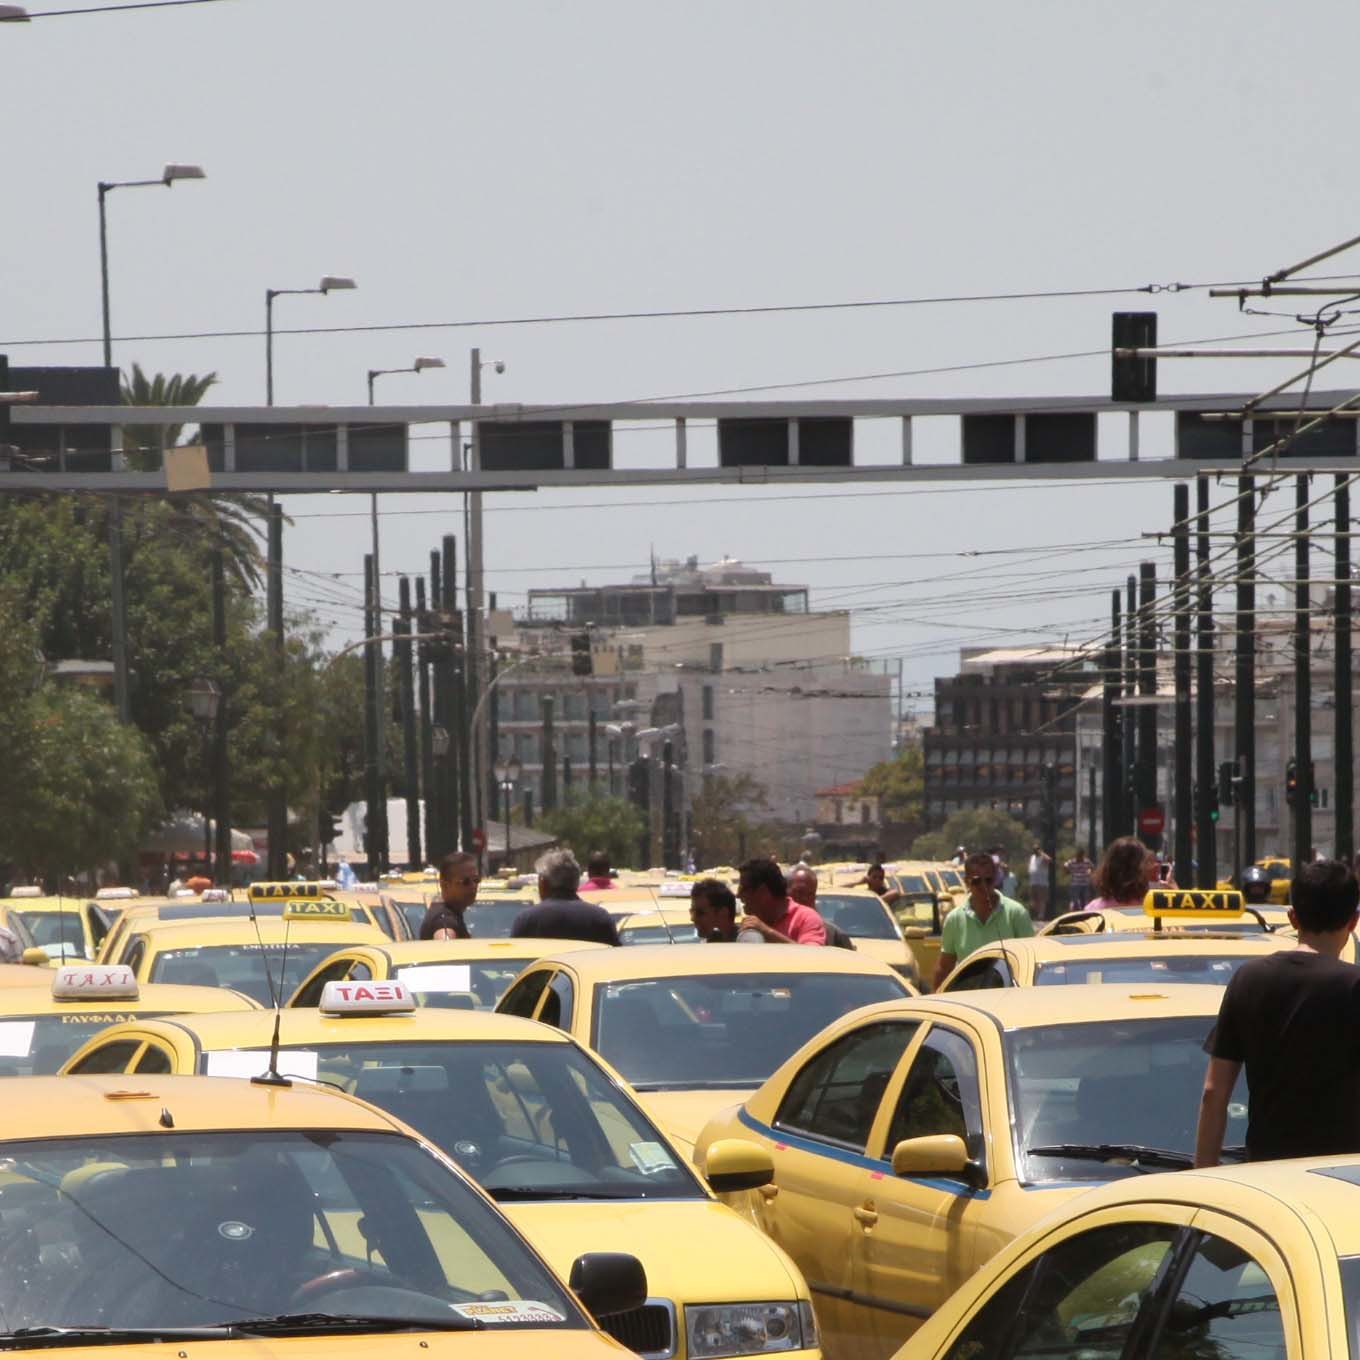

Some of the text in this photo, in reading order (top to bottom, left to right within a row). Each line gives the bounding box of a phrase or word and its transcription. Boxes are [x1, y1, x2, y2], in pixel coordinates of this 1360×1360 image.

[259, 884, 309, 896] TAXI
[291, 902, 344, 914] TAXI
[1163, 893, 1229, 909] TAXI
[63, 972, 129, 986] TAXI
[336, 987, 402, 1001] ΤΑΞΙ
